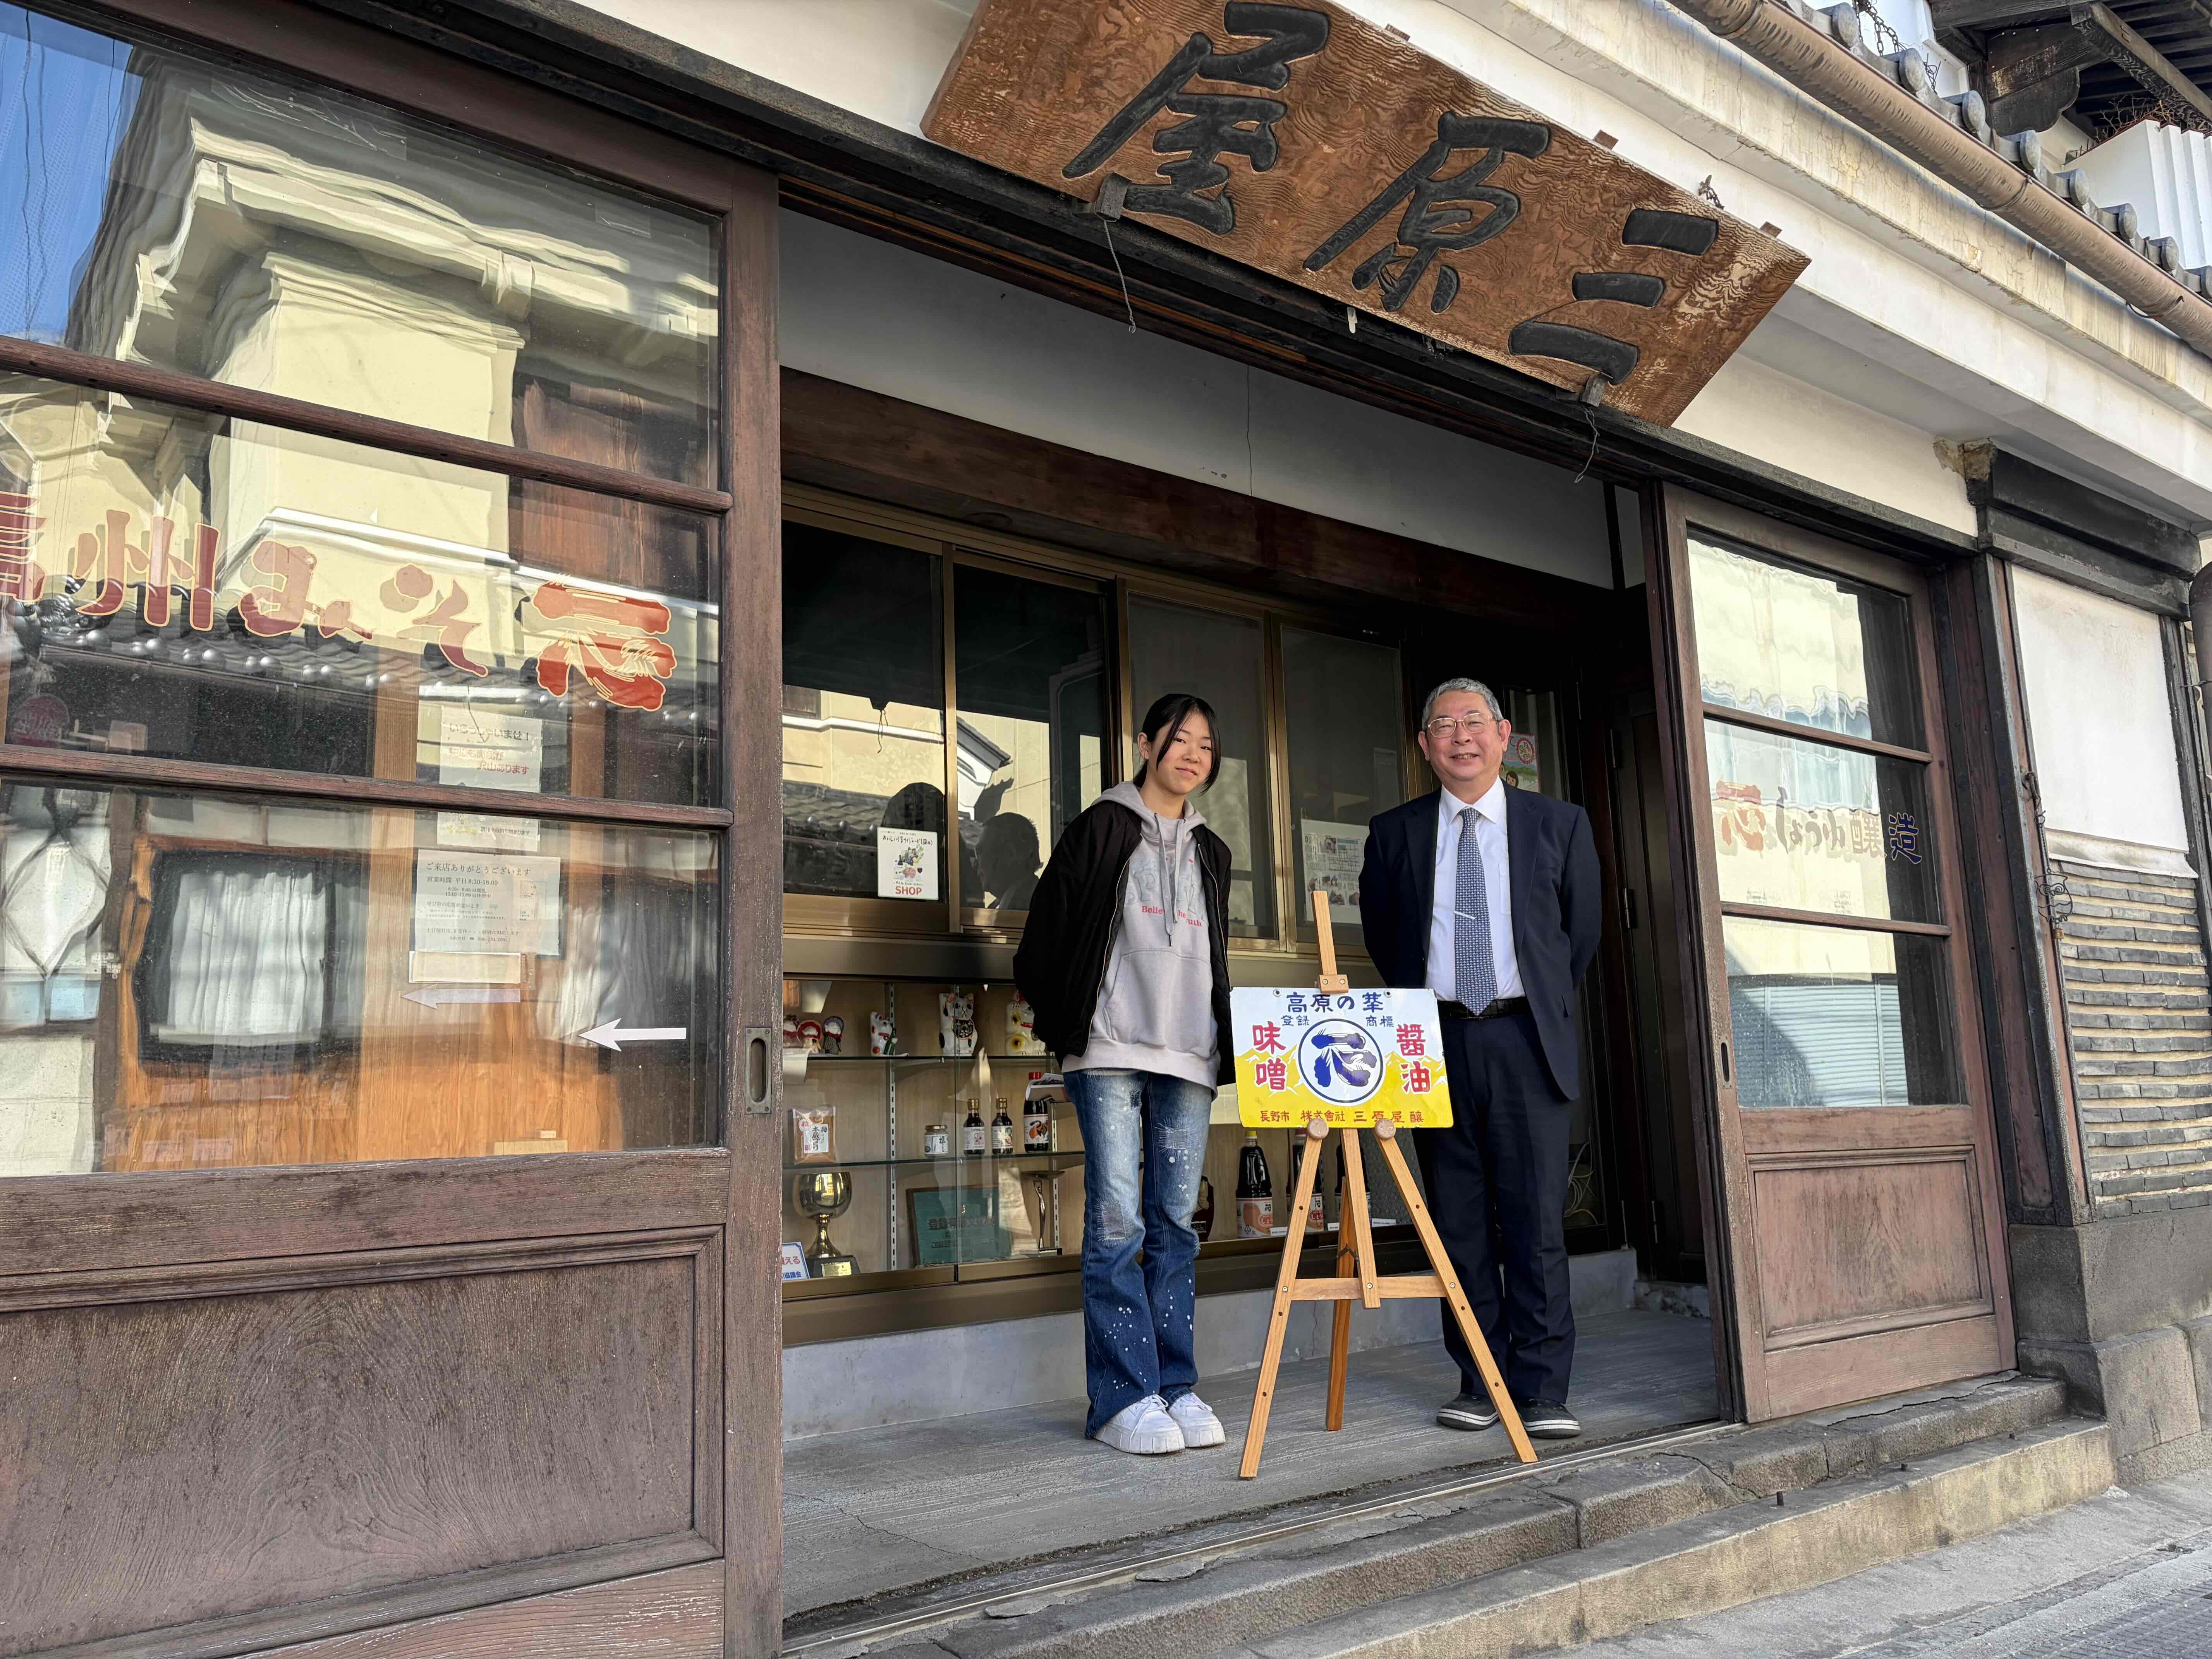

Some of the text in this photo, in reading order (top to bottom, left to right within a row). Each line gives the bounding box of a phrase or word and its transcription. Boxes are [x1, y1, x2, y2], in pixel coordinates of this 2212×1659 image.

[426, 862, 531, 876] ご来店ありがとうございます
[895, 886, 922, 895] SHOP
[1286, 991, 1384, 1013] 高原の華
[1281, 1015, 1394, 1027] 登録 商標
[1252, 1021, 1286, 1090] 味噌
[1260, 1110, 1290, 1122] 長野市
